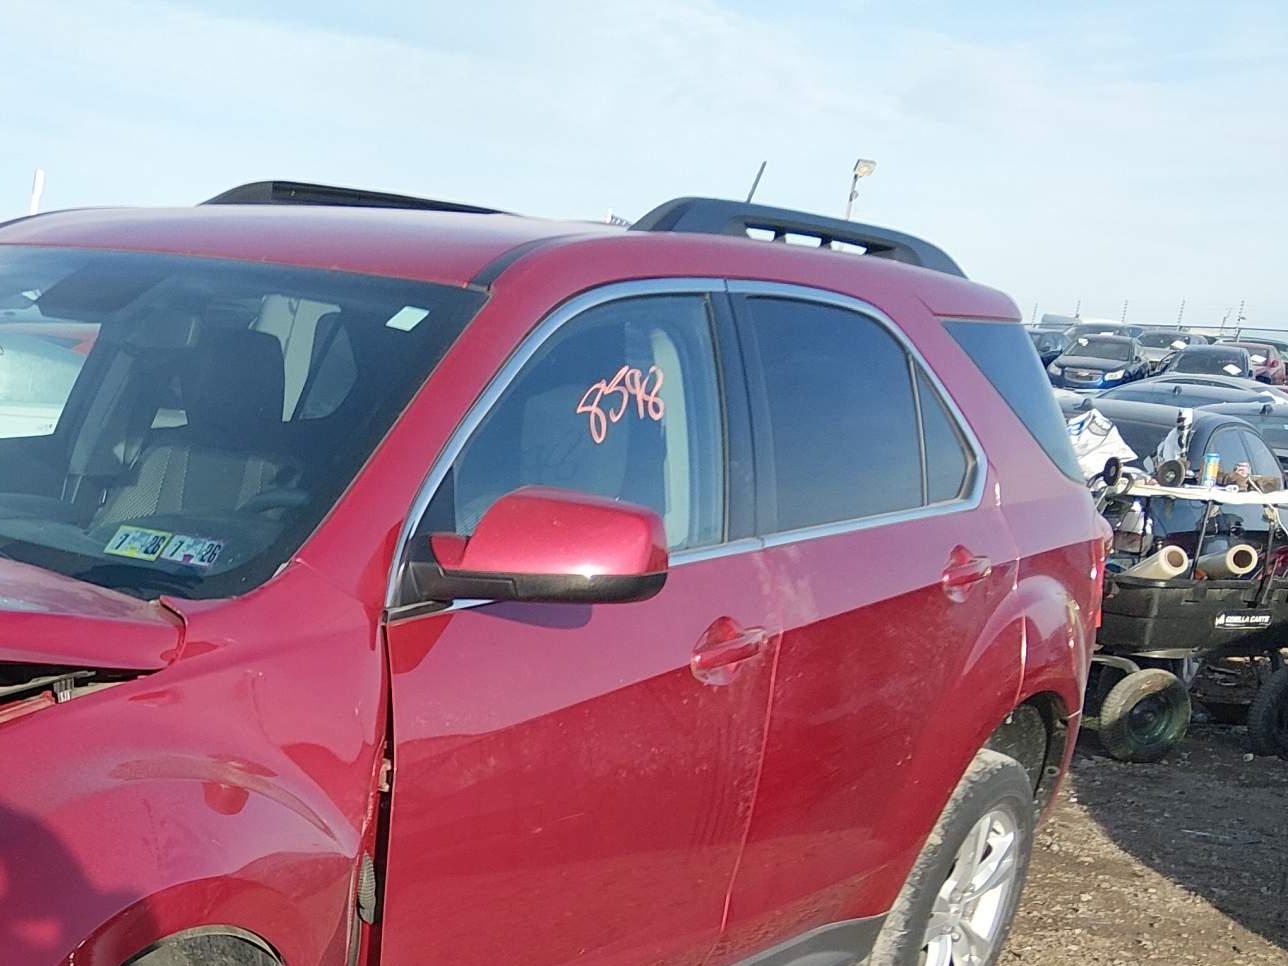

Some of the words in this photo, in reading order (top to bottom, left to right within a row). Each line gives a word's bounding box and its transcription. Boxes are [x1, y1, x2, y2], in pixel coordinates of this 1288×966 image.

[575, 364, 666, 445] 8598
[114, 533, 130, 550] 7
[169, 540, 184, 558] 7
[199, 543, 223, 563] 26
